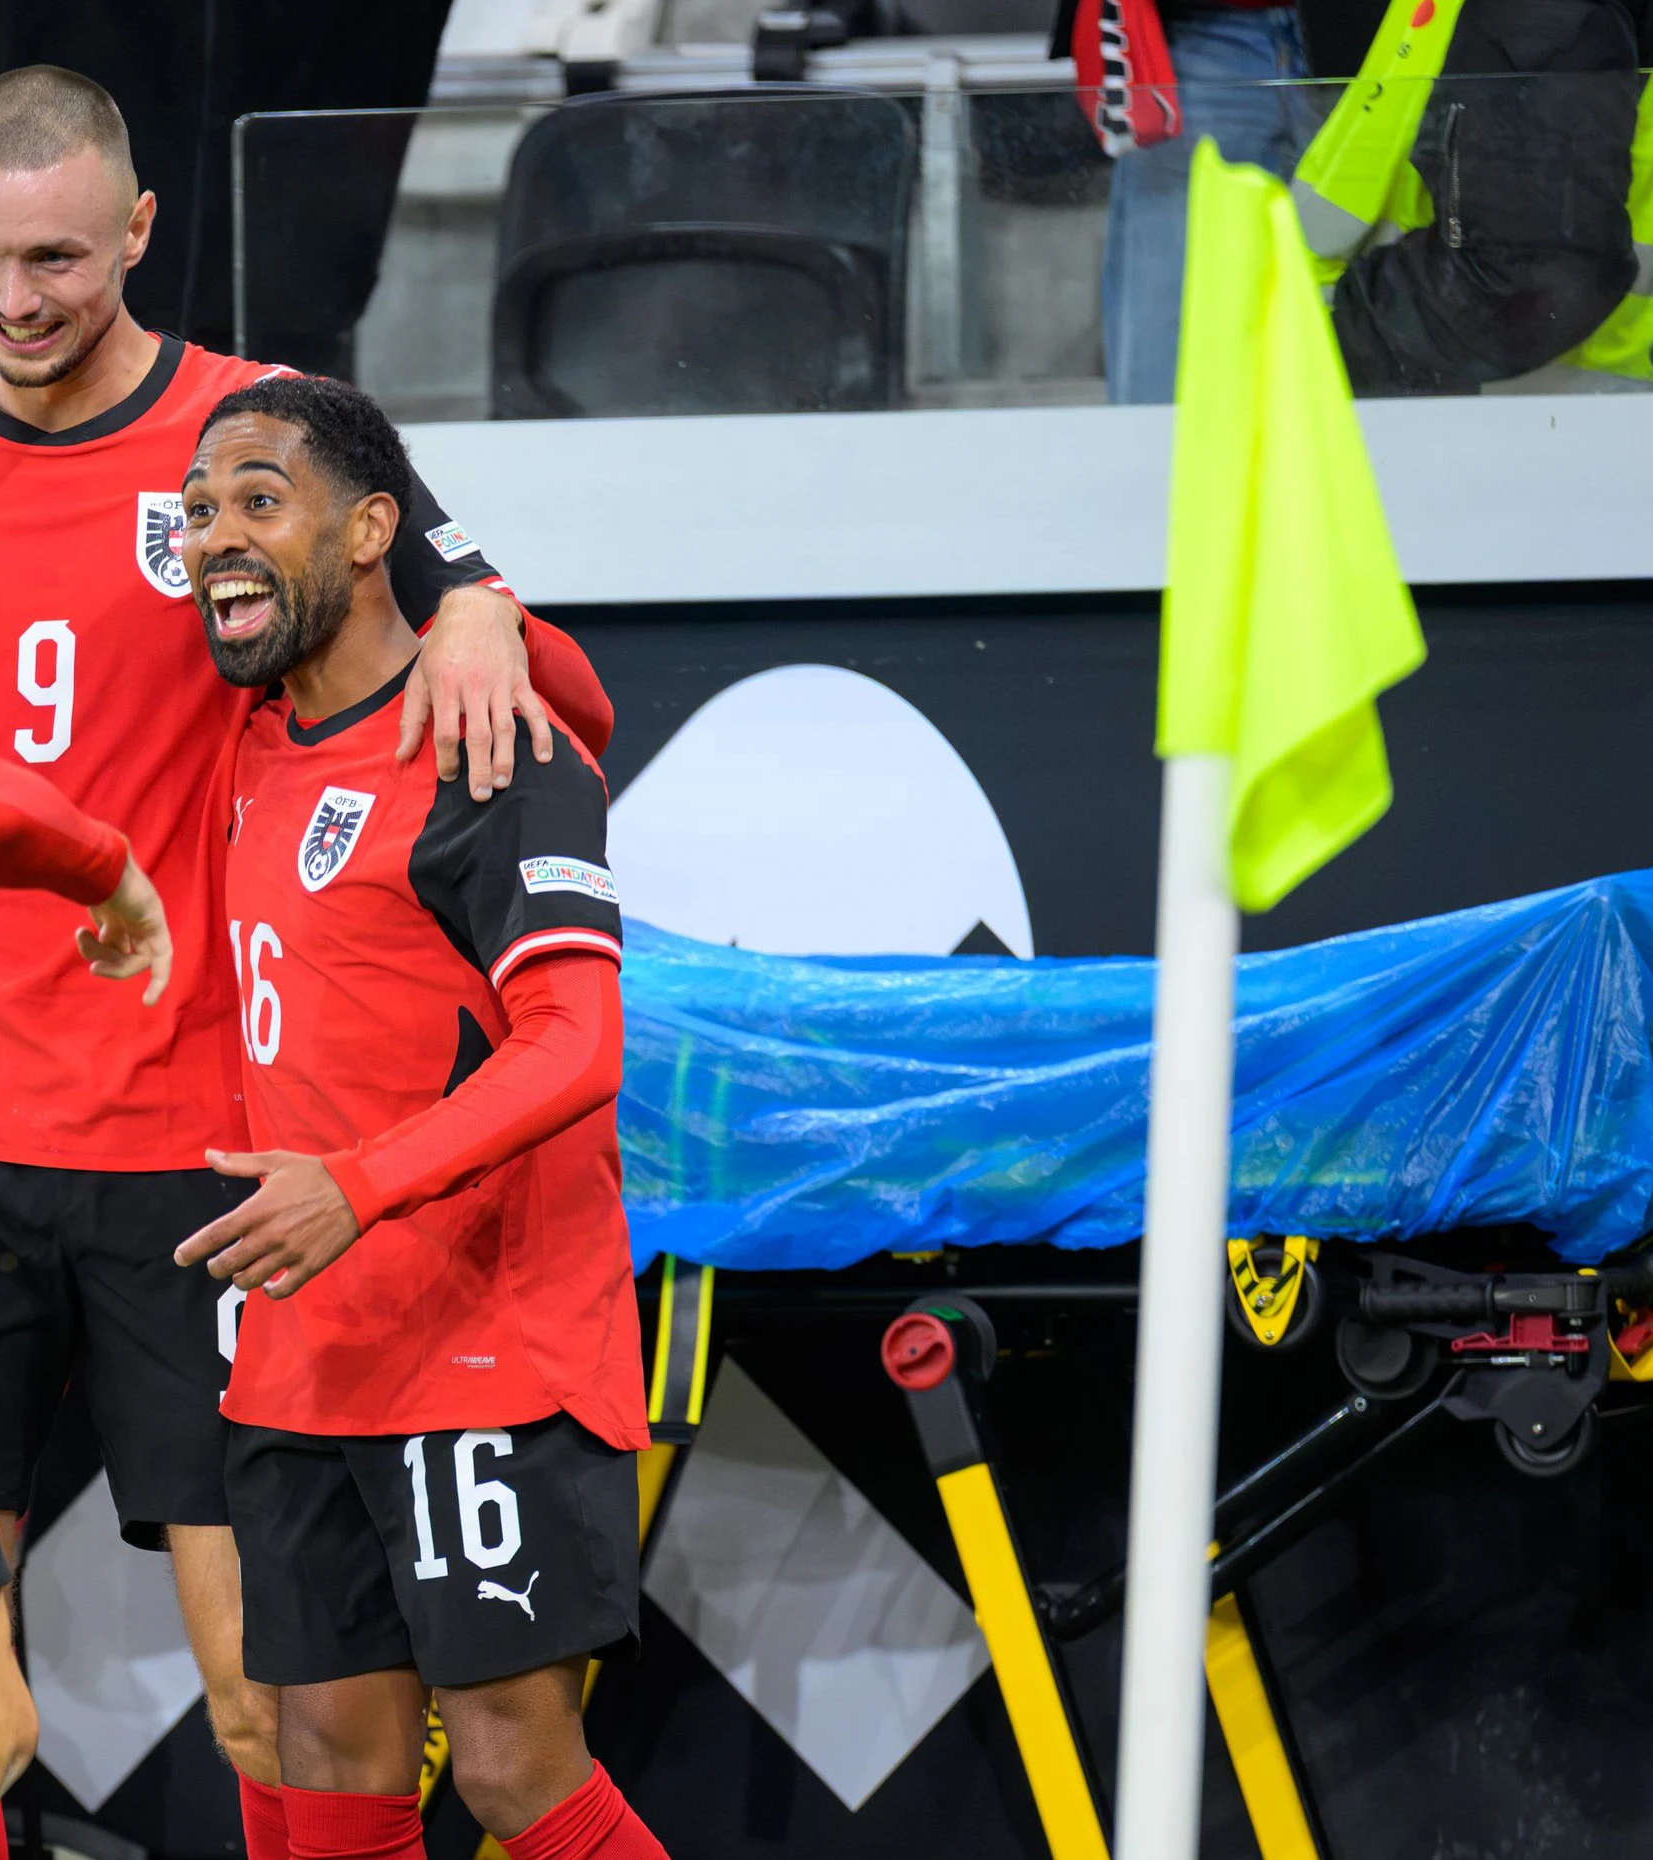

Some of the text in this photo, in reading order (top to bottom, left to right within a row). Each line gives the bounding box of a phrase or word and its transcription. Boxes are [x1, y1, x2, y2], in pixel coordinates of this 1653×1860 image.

[14, 620, 76, 763] 9
[334, 795, 357, 808] ÖFB
[524, 860, 549, 869] UEFA
[526, 867, 615, 892] FOUNDATION
[403, 1428, 522, 1580] 16
